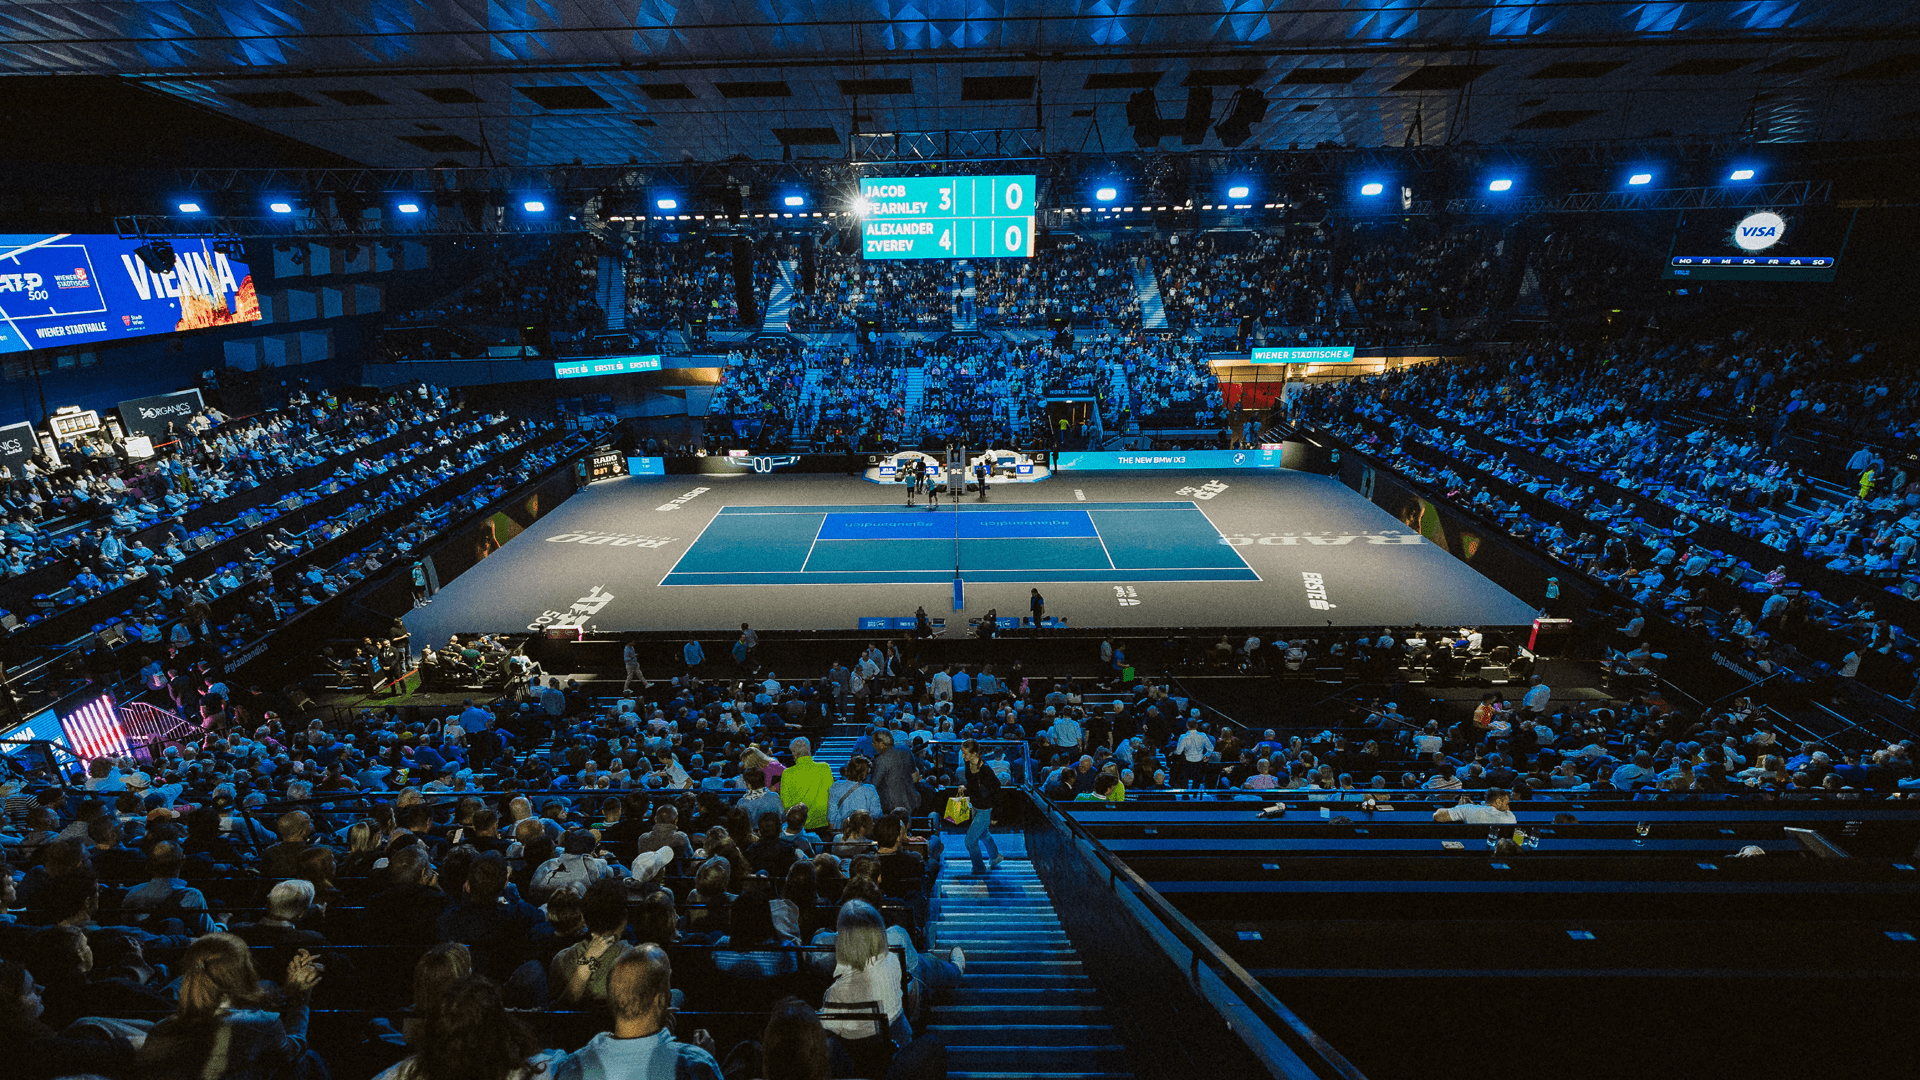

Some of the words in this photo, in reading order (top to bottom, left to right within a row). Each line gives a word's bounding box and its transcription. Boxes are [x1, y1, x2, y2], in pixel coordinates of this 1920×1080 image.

[865, 185, 906, 198] JACOB
[938, 187, 951, 211] 3
[1005, 182, 1023, 210] 0
[866, 222, 934, 236] ALEXANDER
[938, 228, 951, 251] 4
[1004, 225, 1022, 251] 0
[1742, 226, 1776, 237] VISA
[867, 239, 914, 252] ZVEREV
[0, 272, 43, 293] ATP
[54, 273, 78, 281] WIENER
[120, 251, 239, 300] VIENNA
[28, 290, 49, 301] 500
[36, 326, 66, 339] WIENER
[65, 321, 107, 335] STADTHALLE
[1254, 351, 1290, 360] WIENER
[558, 367, 580, 375] ERSTE
[594, 364, 616, 372] ERSTE
[629, 361, 651, 369] ERSTE
[593, 454, 618, 464] RADO
[1118, 456, 1134, 464] THE
[1134, 456, 1153, 464] NEW
[1153, 456, 1173, 464] BMW
[1173, 456, 1186, 464] iX3
[545, 533, 672, 549] RADO
[1218, 534, 1429, 546] RADO
[1301, 571, 1328, 600] ERSTE
[224, 642, 269, 675] #glaubandich
